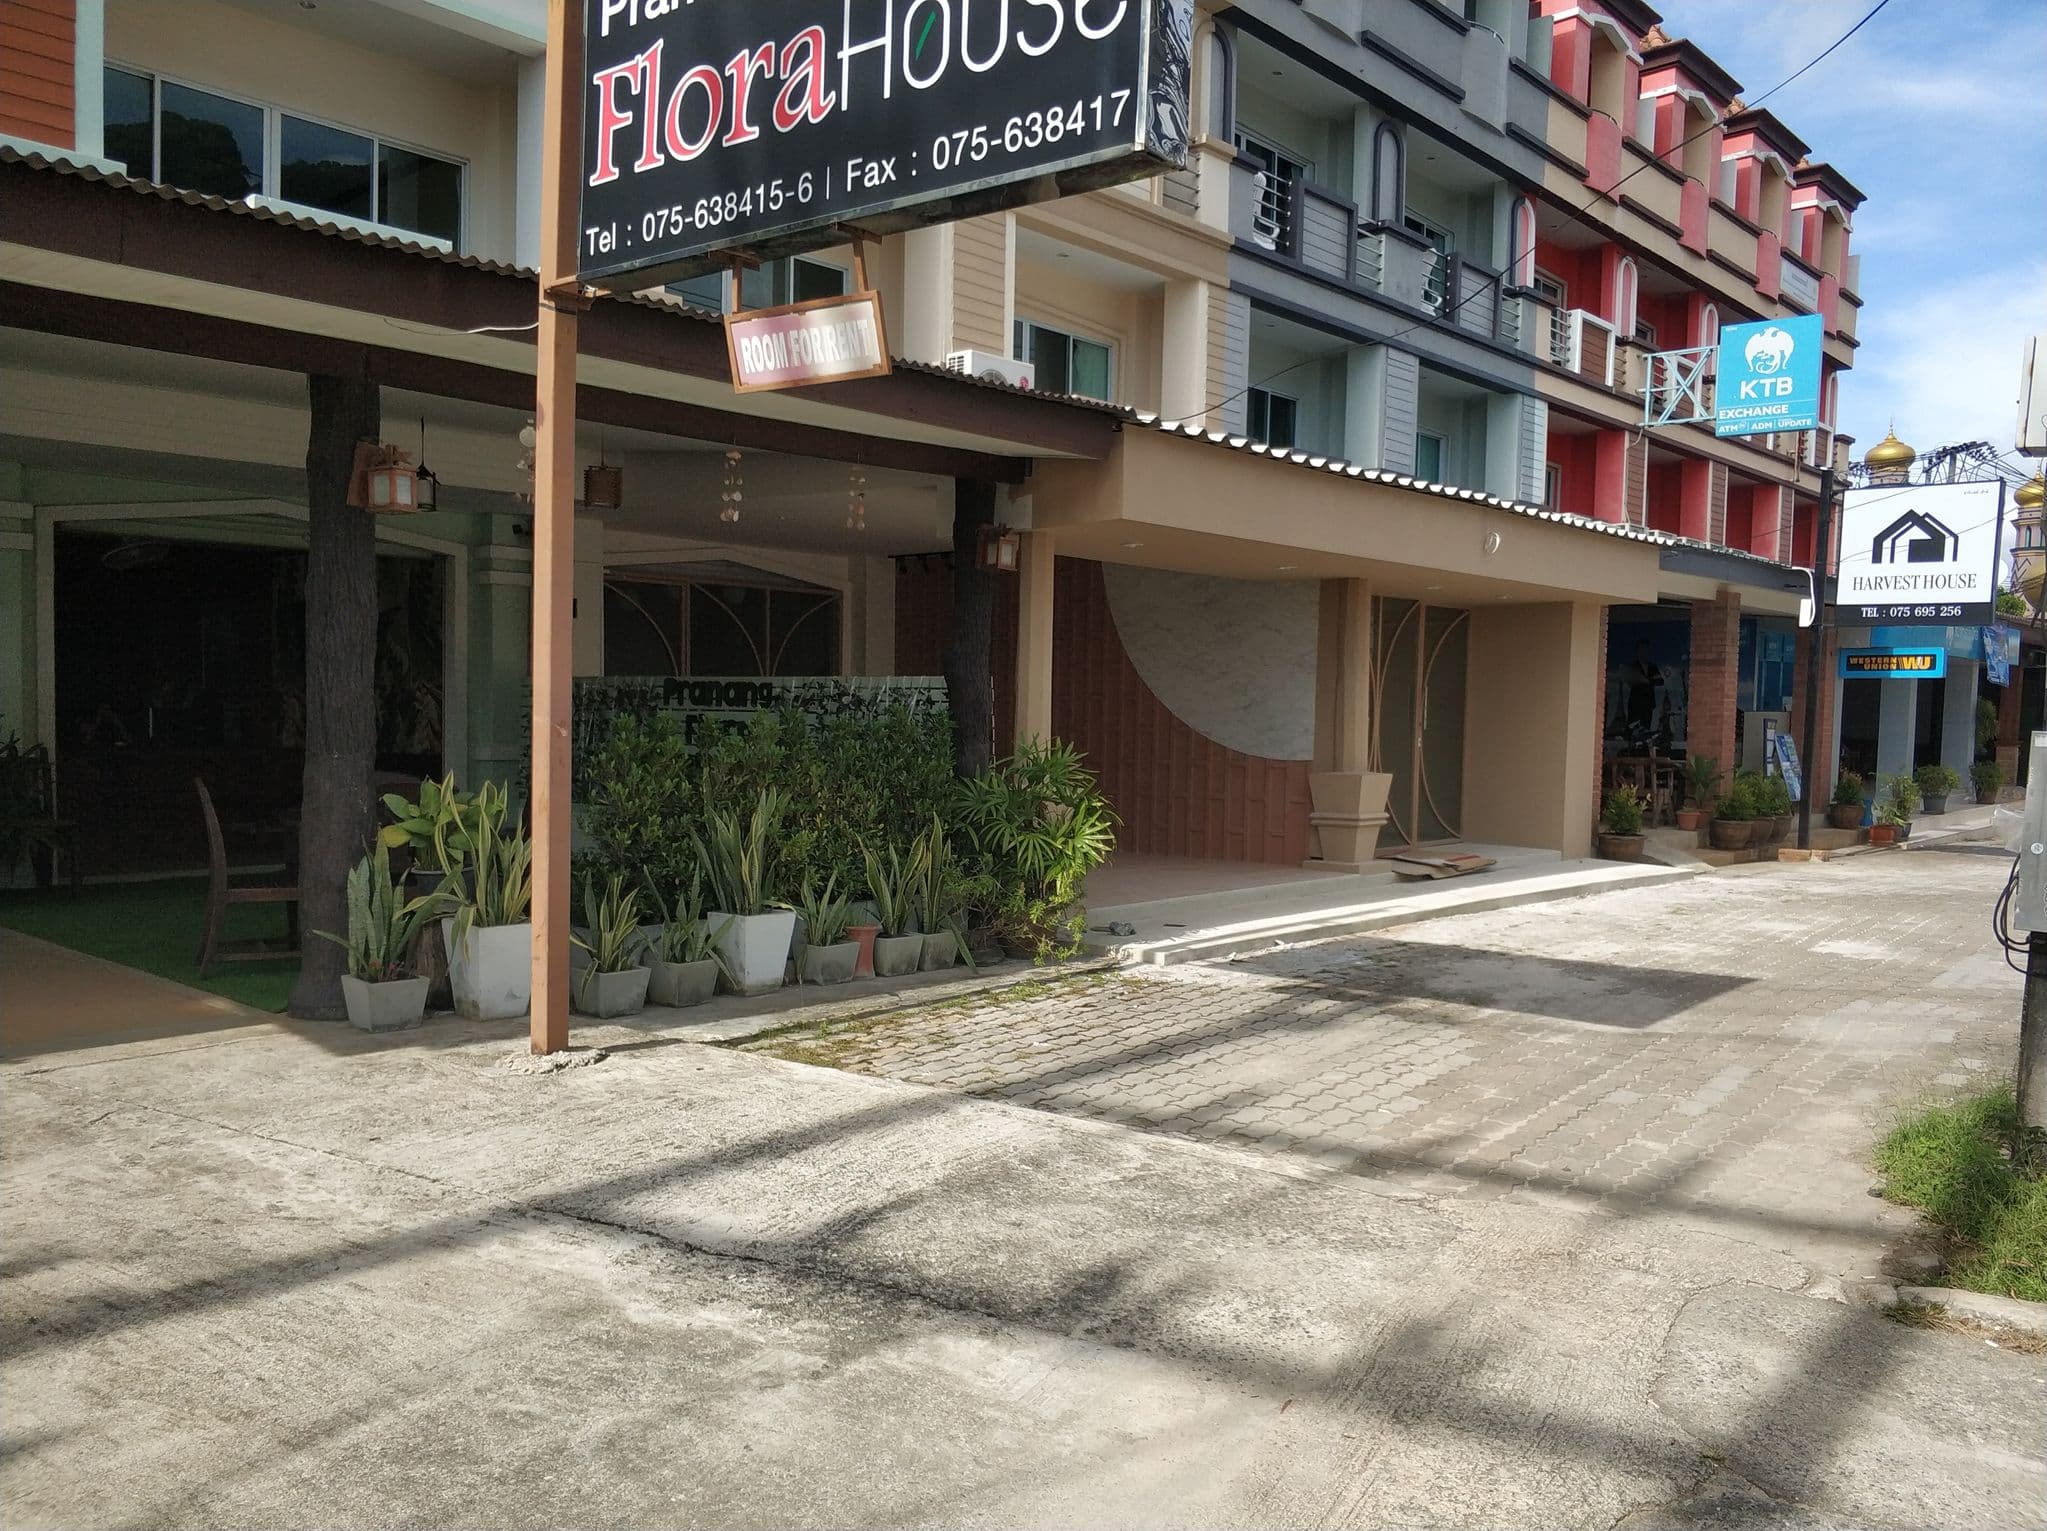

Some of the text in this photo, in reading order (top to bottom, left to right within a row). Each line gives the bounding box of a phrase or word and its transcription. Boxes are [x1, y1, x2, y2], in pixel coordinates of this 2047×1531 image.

[586, 222, 616, 256] Tel
[642, 172, 813, 242] 075-638415-6
[846, 157, 897, 192] Fax
[932, 89, 1131, 170] 075-638417
[740, 332, 788, 374] ROOM
[1740, 376, 1793, 400] KTB
[1718, 404, 1789, 420] EXCHANGE
[1718, 424, 1738, 433] ATM
[1751, 421, 1773, 430] ADM
[1778, 418, 1812, 428] UPDATE
[1853, 573, 1977, 591] HARVEST HOUSE
[1860, 607, 1880, 618] TEL
[1889, 607, 1911, 618] 075
[1914, 606, 1936, 617] 695
[1939, 606, 1962, 617] 256
[1849, 656, 1931, 670] WESTERN WU
